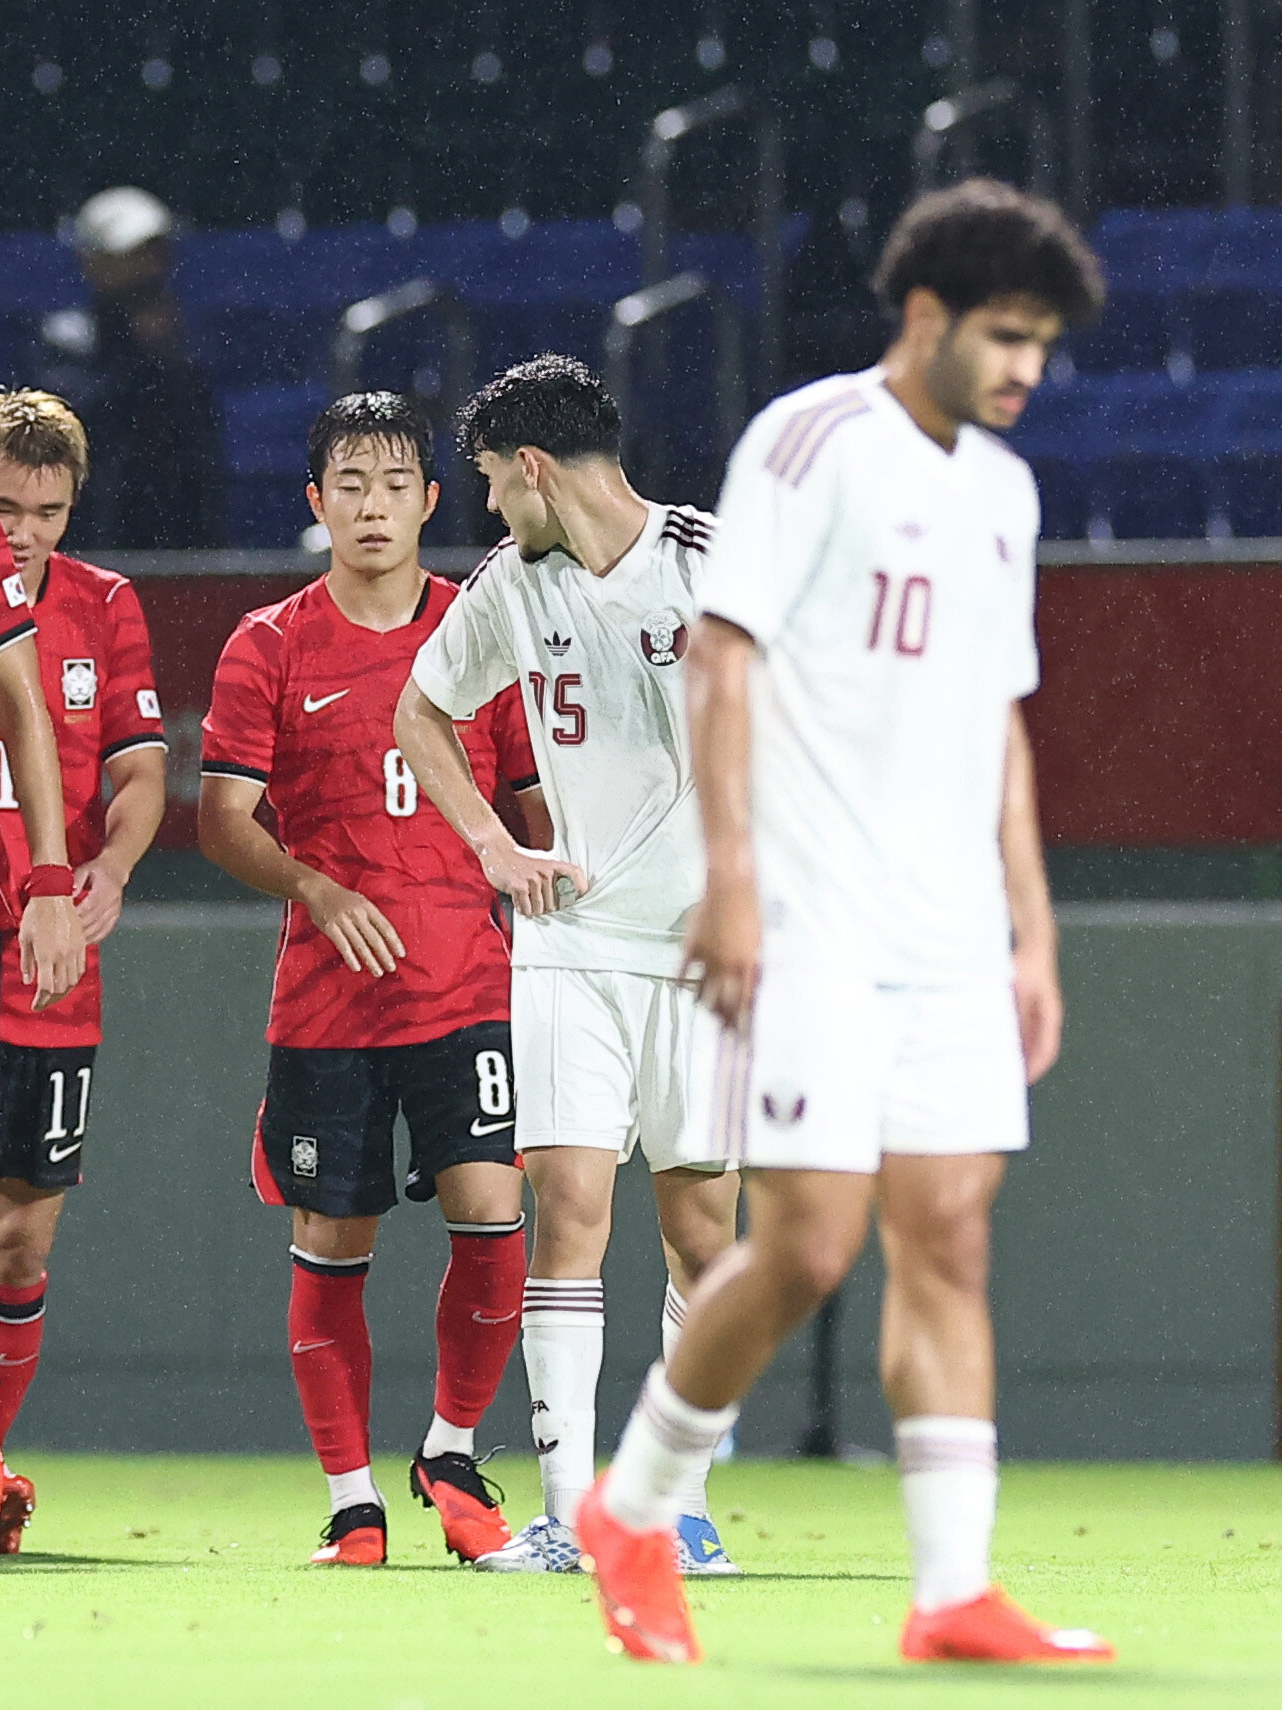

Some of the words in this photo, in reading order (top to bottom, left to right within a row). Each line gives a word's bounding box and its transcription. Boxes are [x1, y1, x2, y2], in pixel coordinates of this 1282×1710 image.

[868, 570, 931, 655] 10
[650, 651, 677, 664] QFA
[383, 748, 418, 817] 8
[43, 1067, 92, 1141] 11
[475, 1050, 511, 1116] 8
